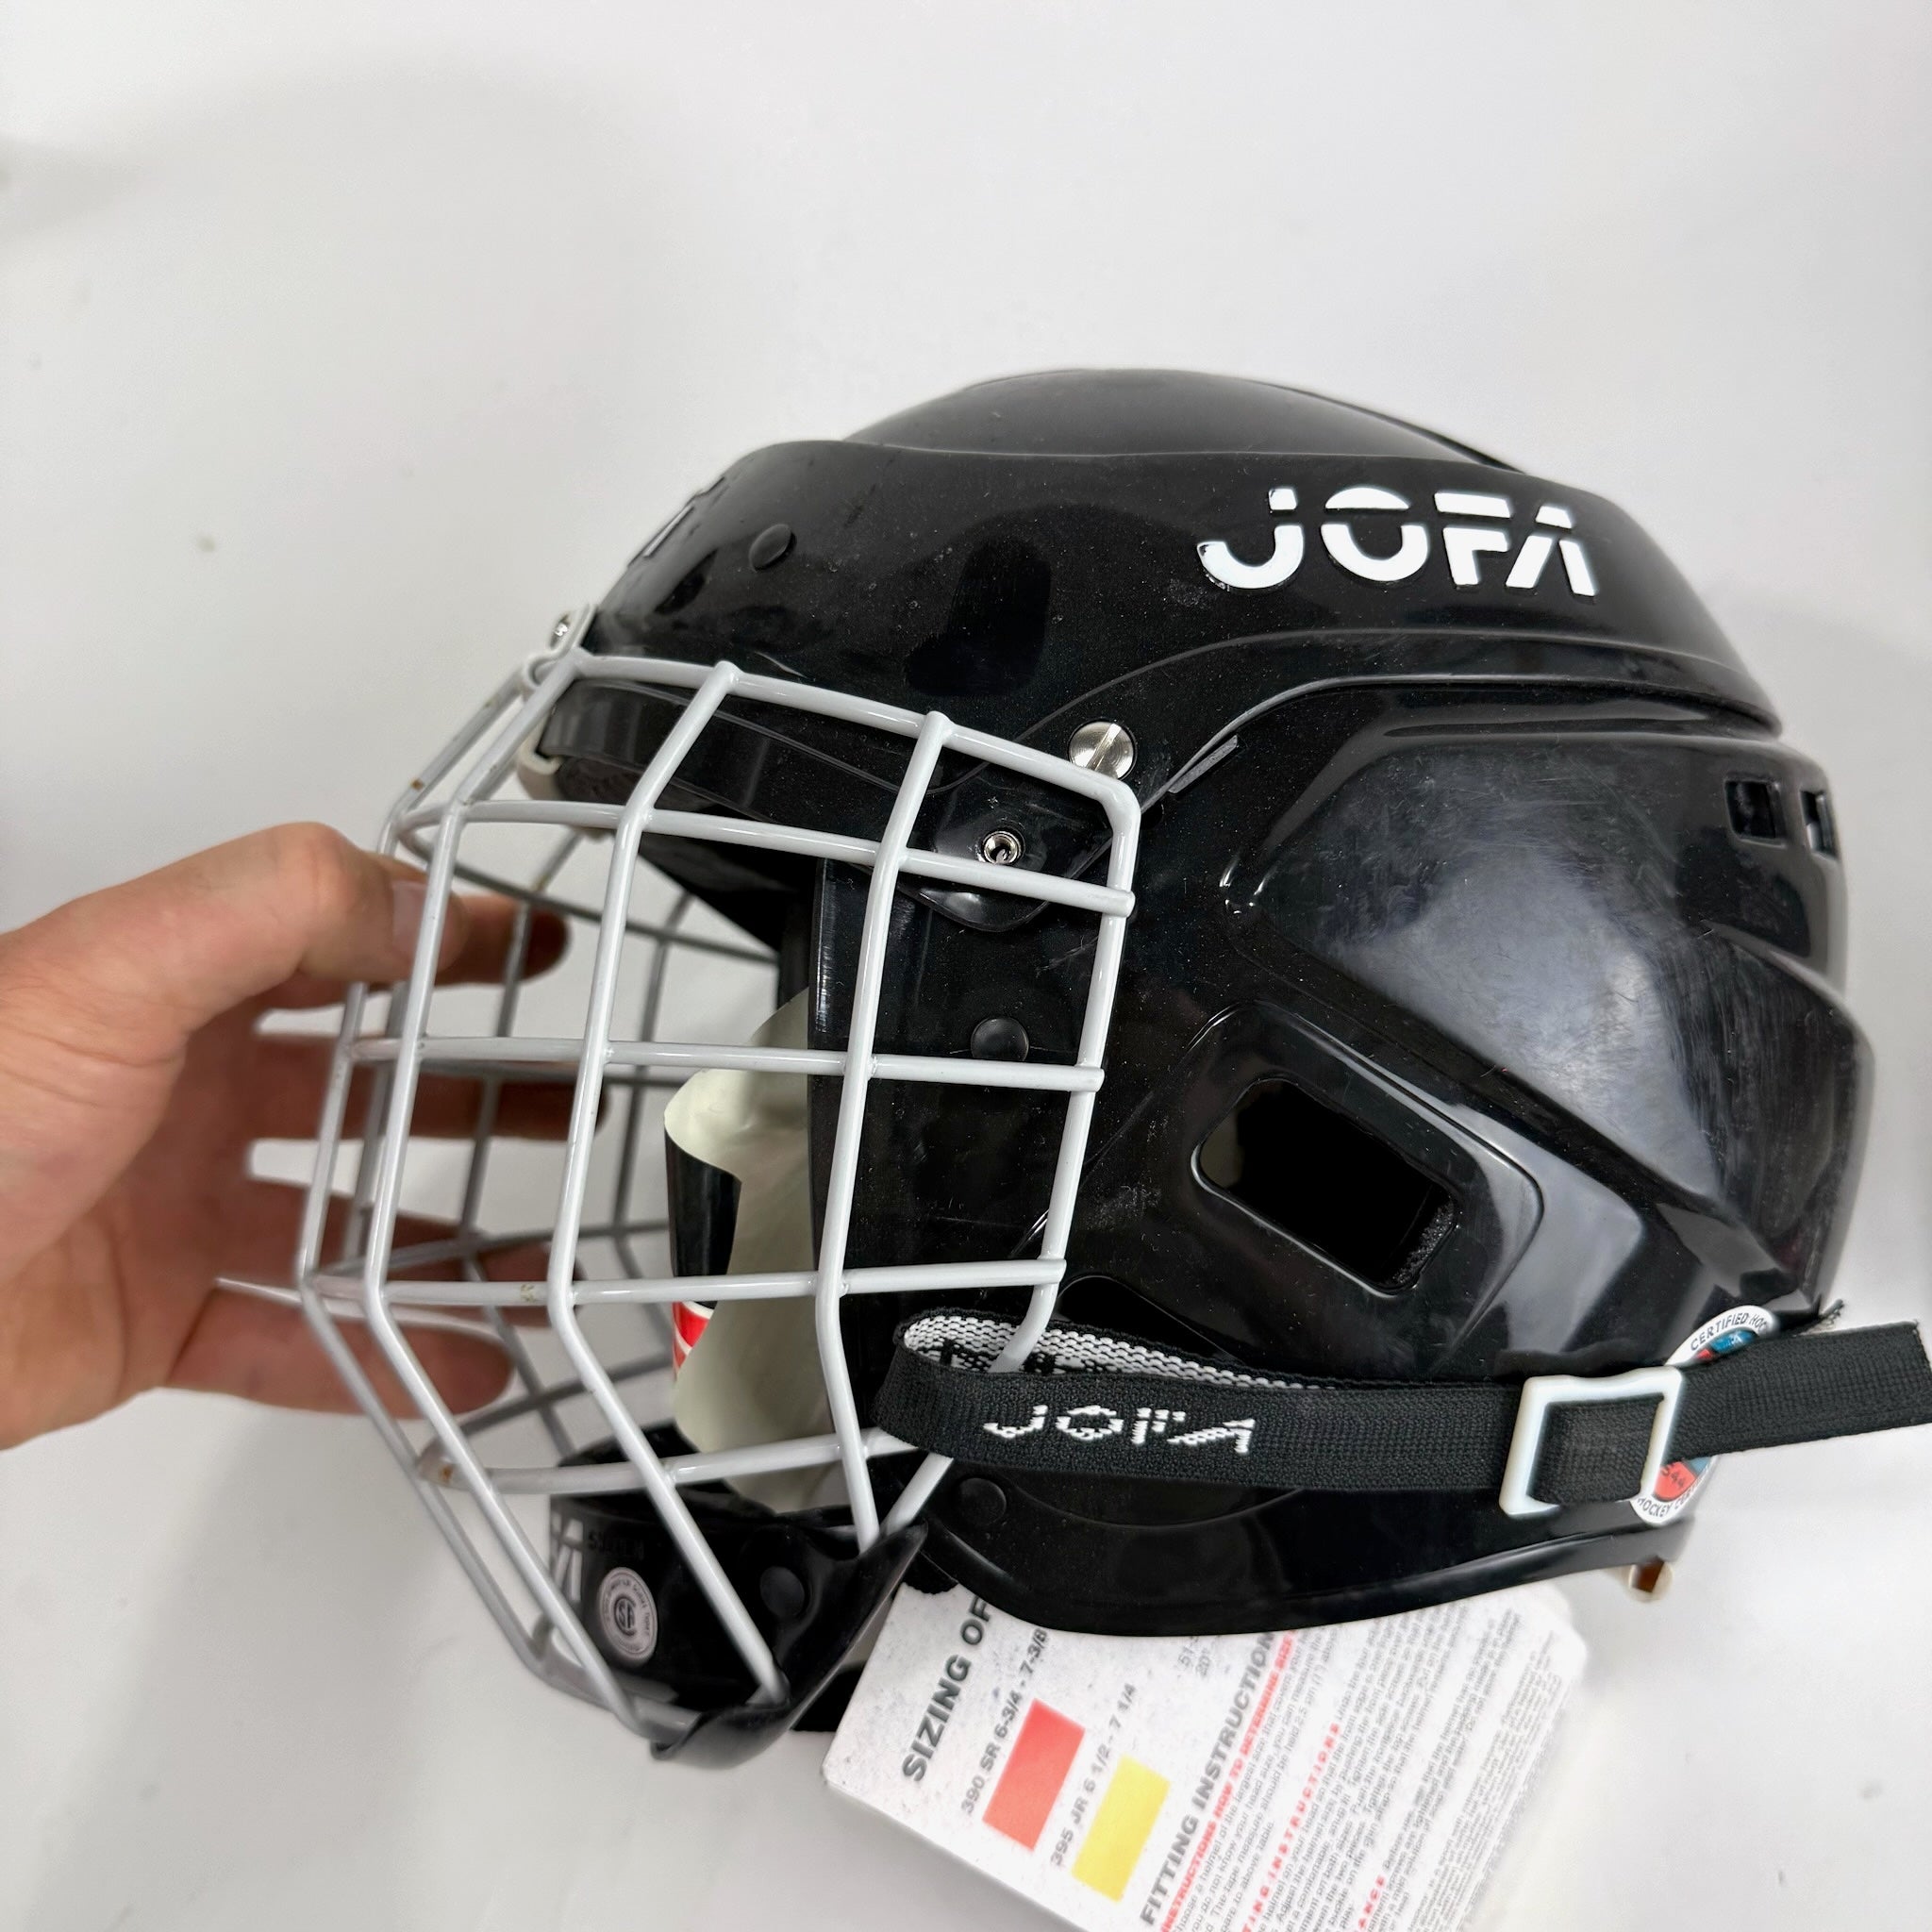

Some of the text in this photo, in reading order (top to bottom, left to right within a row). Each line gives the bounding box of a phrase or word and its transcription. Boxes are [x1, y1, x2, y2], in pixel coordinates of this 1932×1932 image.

[1196, 487, 1598, 597] JOFA
[1690, 1312, 1749, 1352] CERTIFIED
[982, 1405, 1256, 1455] JOFA
[902, 1597, 991, 1782] SIZING OF
[960, 1777, 985, 1816] 390
[980, 1740, 1001, 1771] SR
[993, 1690, 1024, 1739] 6-3/4
[1050, 1828, 1074, 1867] 395
[1073, 1795, 1090, 1825] JR
[1083, 1777, 1097, 1792] 6
[1091, 1743, 1111, 1774] 1/2
[1108, 1715, 1122, 1731] 7
[1138, 1812, 1198, 1926] FITTING
